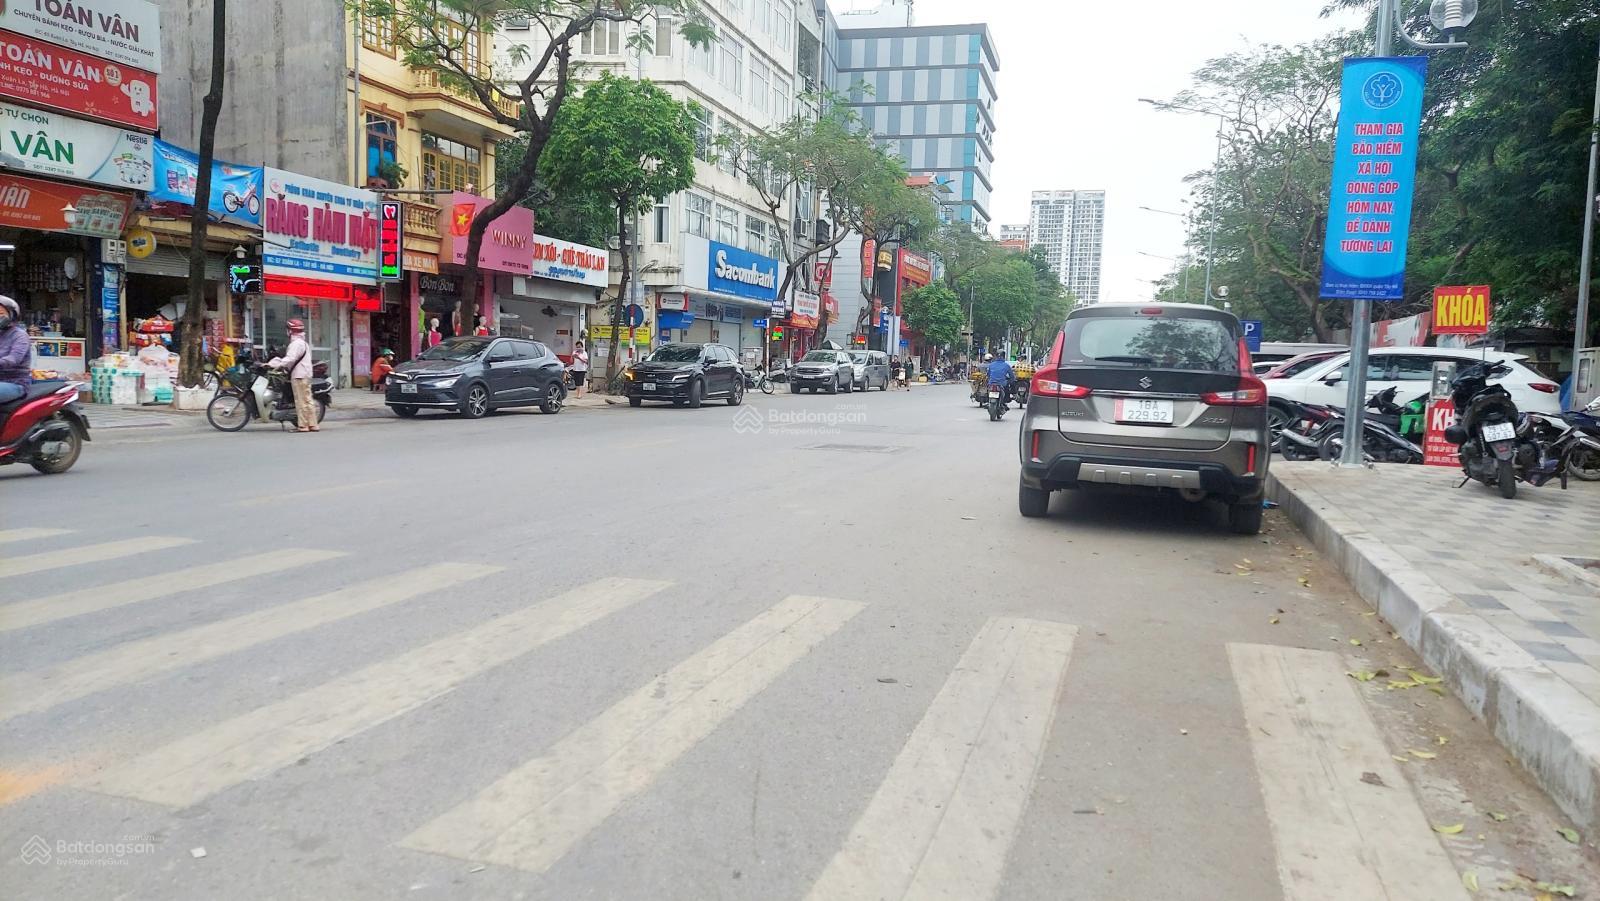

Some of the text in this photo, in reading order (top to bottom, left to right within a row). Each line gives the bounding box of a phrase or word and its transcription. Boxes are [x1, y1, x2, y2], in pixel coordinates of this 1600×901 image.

[13, 8, 41, 22] CHUYÊN
[60, 23, 74, 32] KẸO
[98, 13, 140, 43] VÂN
[14, 65, 32, 76] KẸO
[72, 80, 89, 92] SỮA
[59, 59, 100, 84] VÂN
[5, 108, 19, 120] TỰ
[20, 112, 49, 125] CHỌN
[1355, 122, 1403, 136] THAM GIA
[10, 130, 74, 165] VÂN
[1352, 138, 1403, 156] BẢO HIỂM
[1358, 160, 1392, 177] XÃ HỘI
[1378, 179, 1399, 194] GÓP
[1346, 199, 1371, 214] HÔM
[266, 193, 309, 238] RĂNG
[312, 202, 346, 246] HÀM
[348, 208, 378, 254] MẶT
[1346, 216, 1391, 233] ĐỂ DÀNH
[492, 230, 528, 249] WINNY
[1341, 239, 1393, 253] TƯƠNG LAI
[591, 254, 605, 271] LAN
[714, 250, 776, 289] Sacombank
[1436, 288, 1486, 327] KHÓA
[1244, 322, 1254, 336] P
[1128, 410, 1168, 421] 229.92
